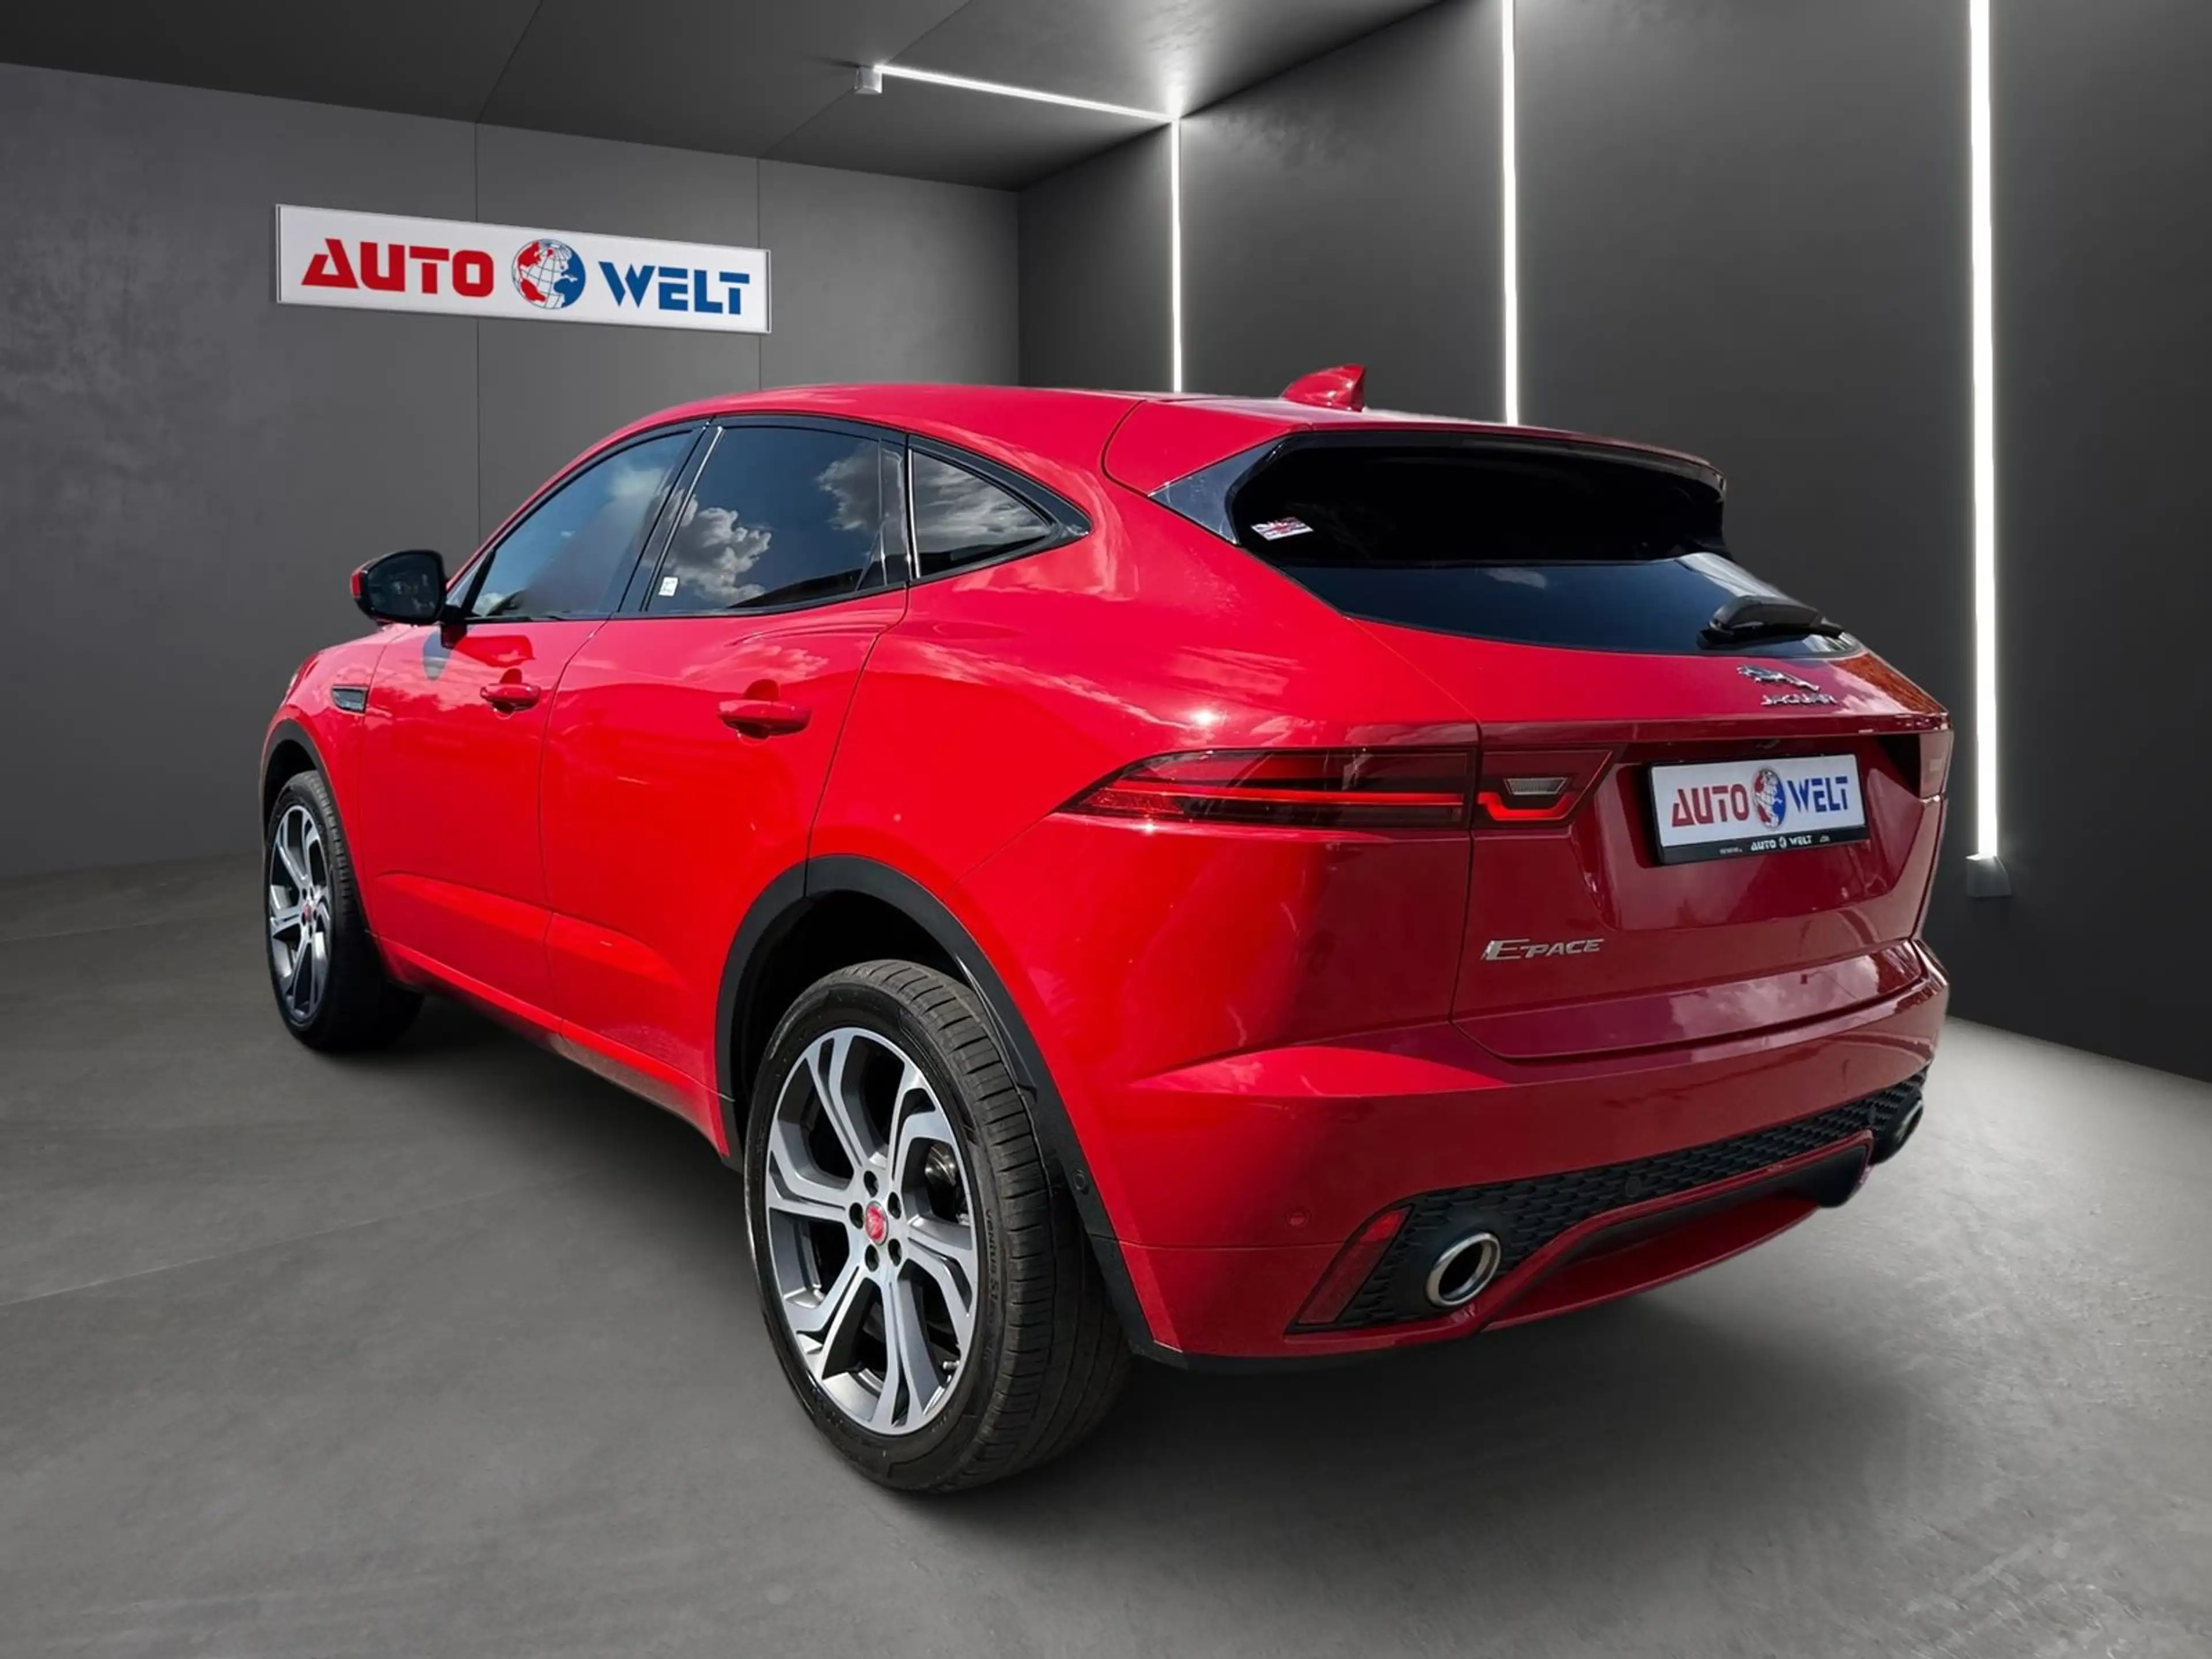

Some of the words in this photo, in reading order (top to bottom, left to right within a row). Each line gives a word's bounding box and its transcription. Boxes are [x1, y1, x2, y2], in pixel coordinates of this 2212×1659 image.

[301, 238, 494, 298] AUTO
[599, 262, 751, 315] WELT
[1672, 783, 1749, 827] AUTO
[1787, 776, 1848, 813] WELT
[1751, 839, 1777, 851] AUTO
[1789, 835, 1813, 846] WELT
